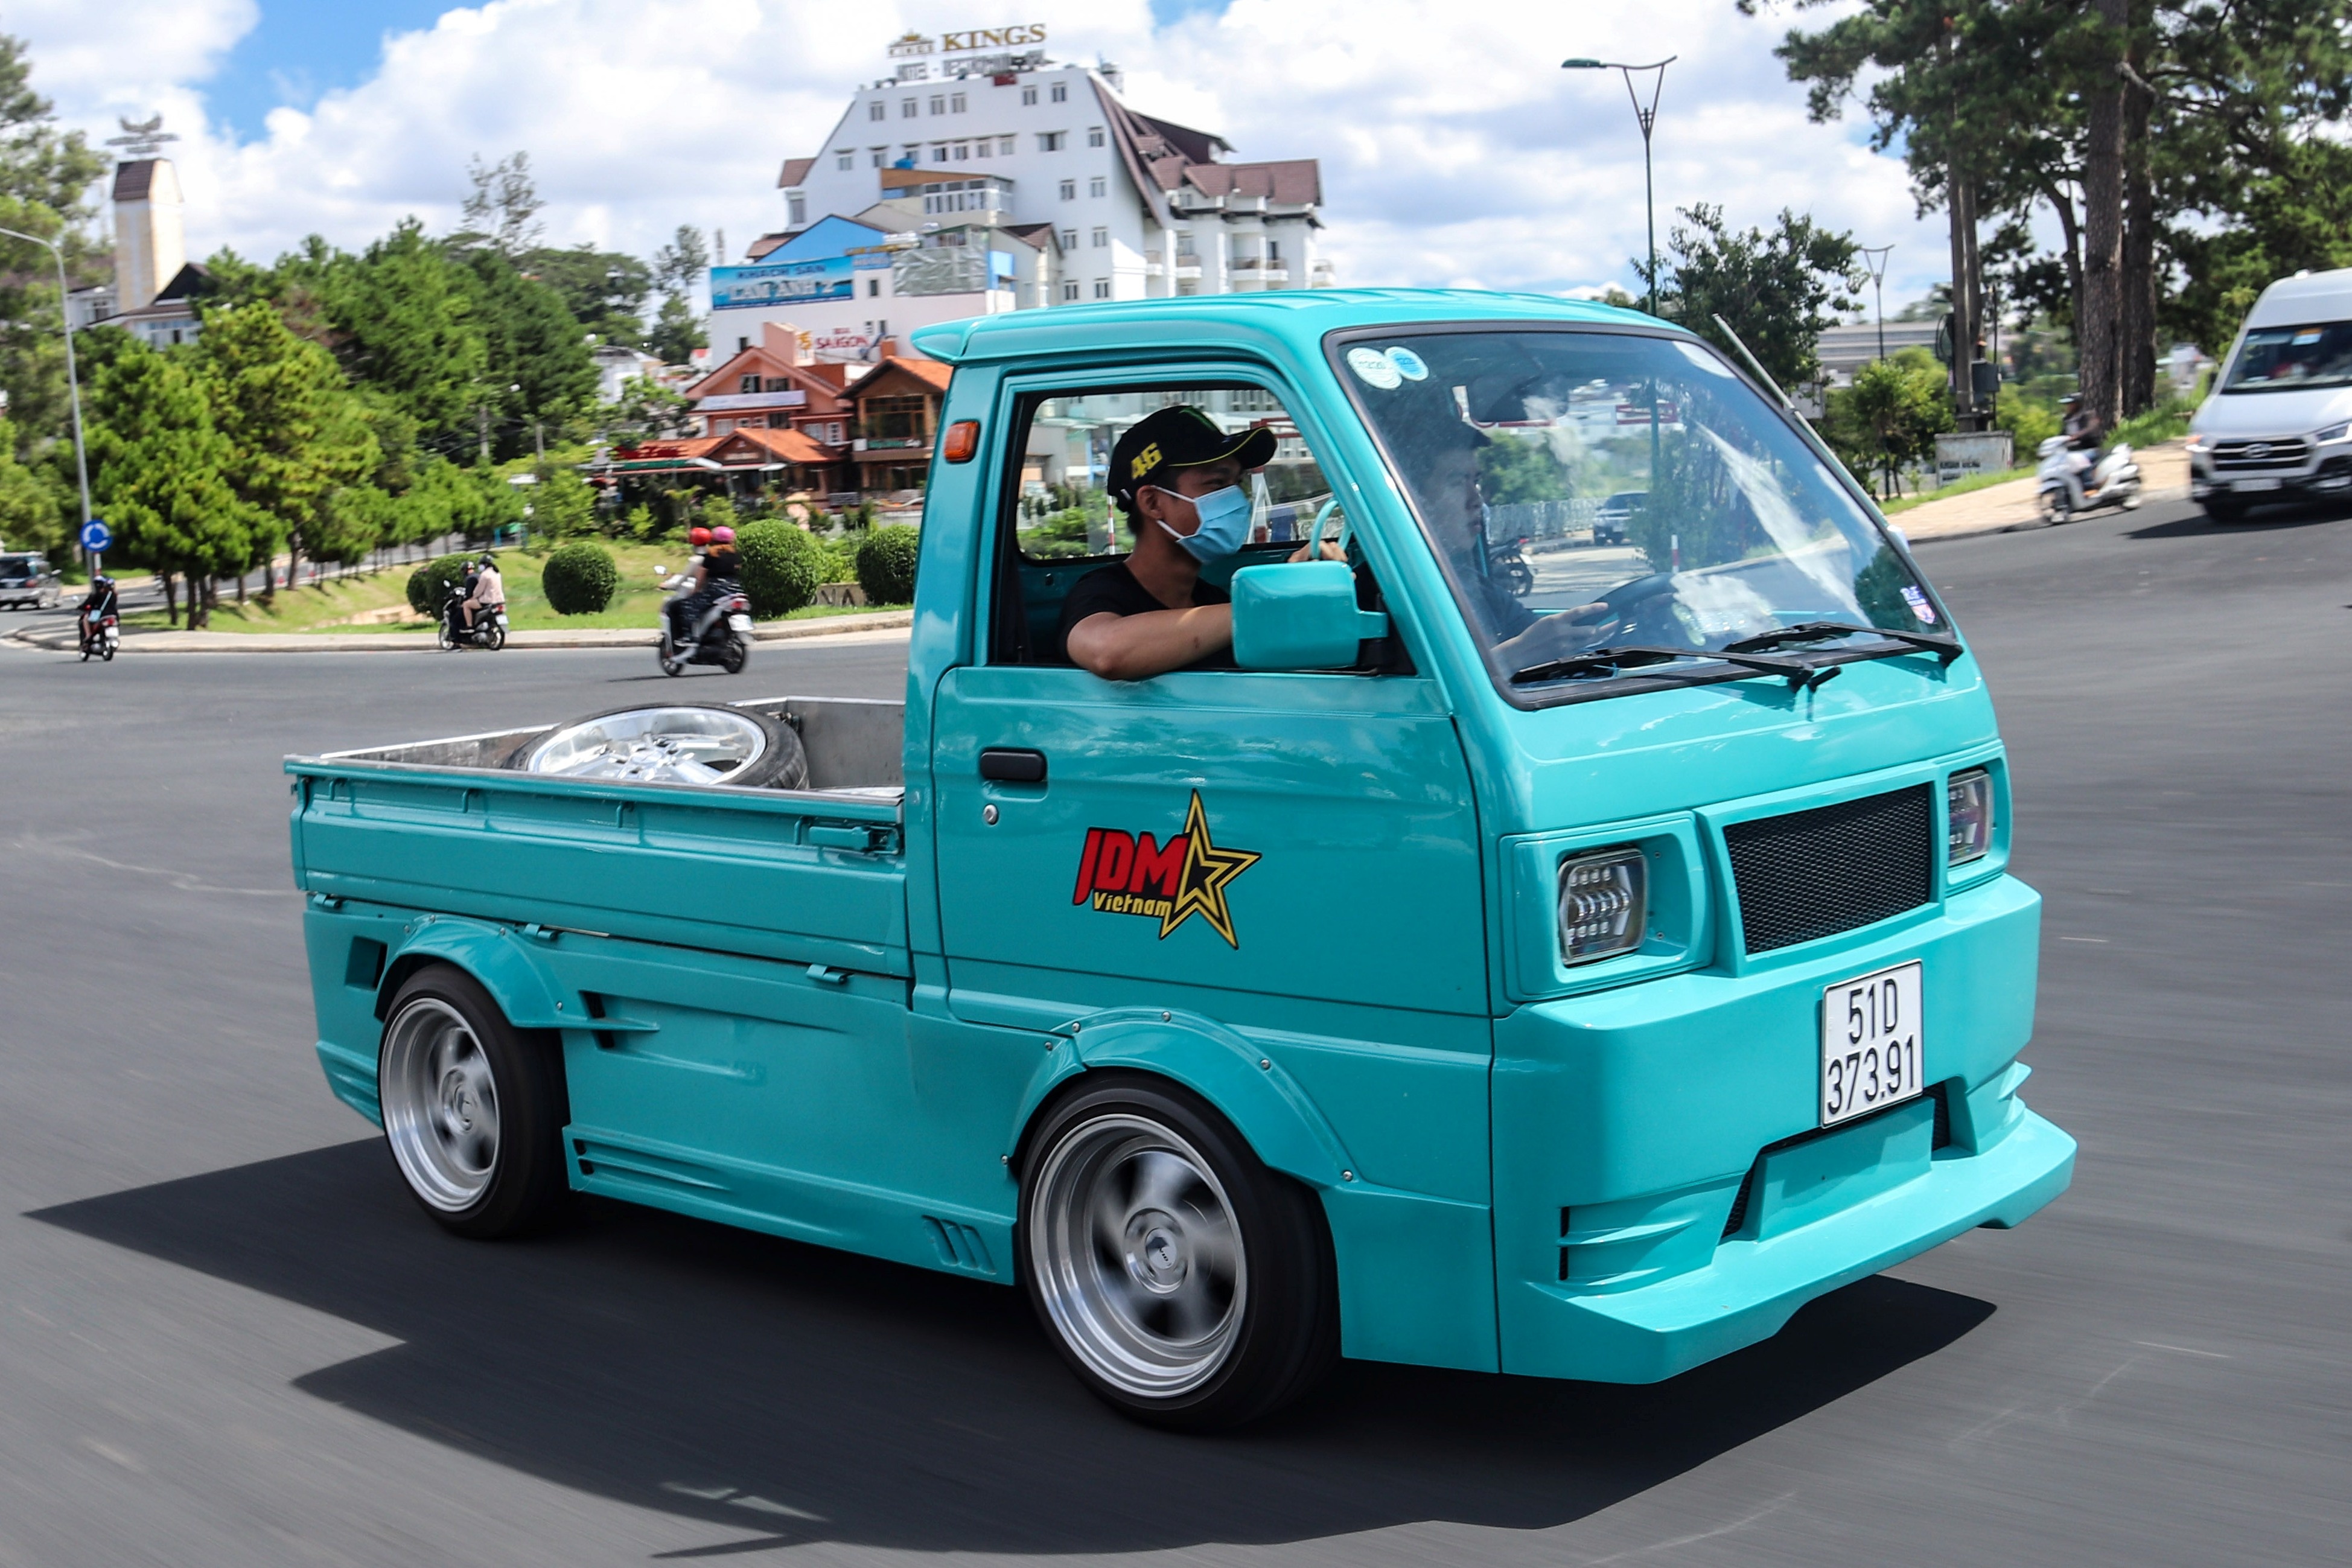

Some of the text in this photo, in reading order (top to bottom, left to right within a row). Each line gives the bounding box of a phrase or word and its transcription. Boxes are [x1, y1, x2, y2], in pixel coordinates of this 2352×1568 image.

[942, 22, 1047, 51] KINGS
[1130, 442, 1162, 479] 46
[1072, 828, 1190, 905] JDM
[1093, 891, 1173, 917] Vietnam
[1847, 978, 1899, 1045] 51D
[1826, 1034, 1914, 1115] 373.91
